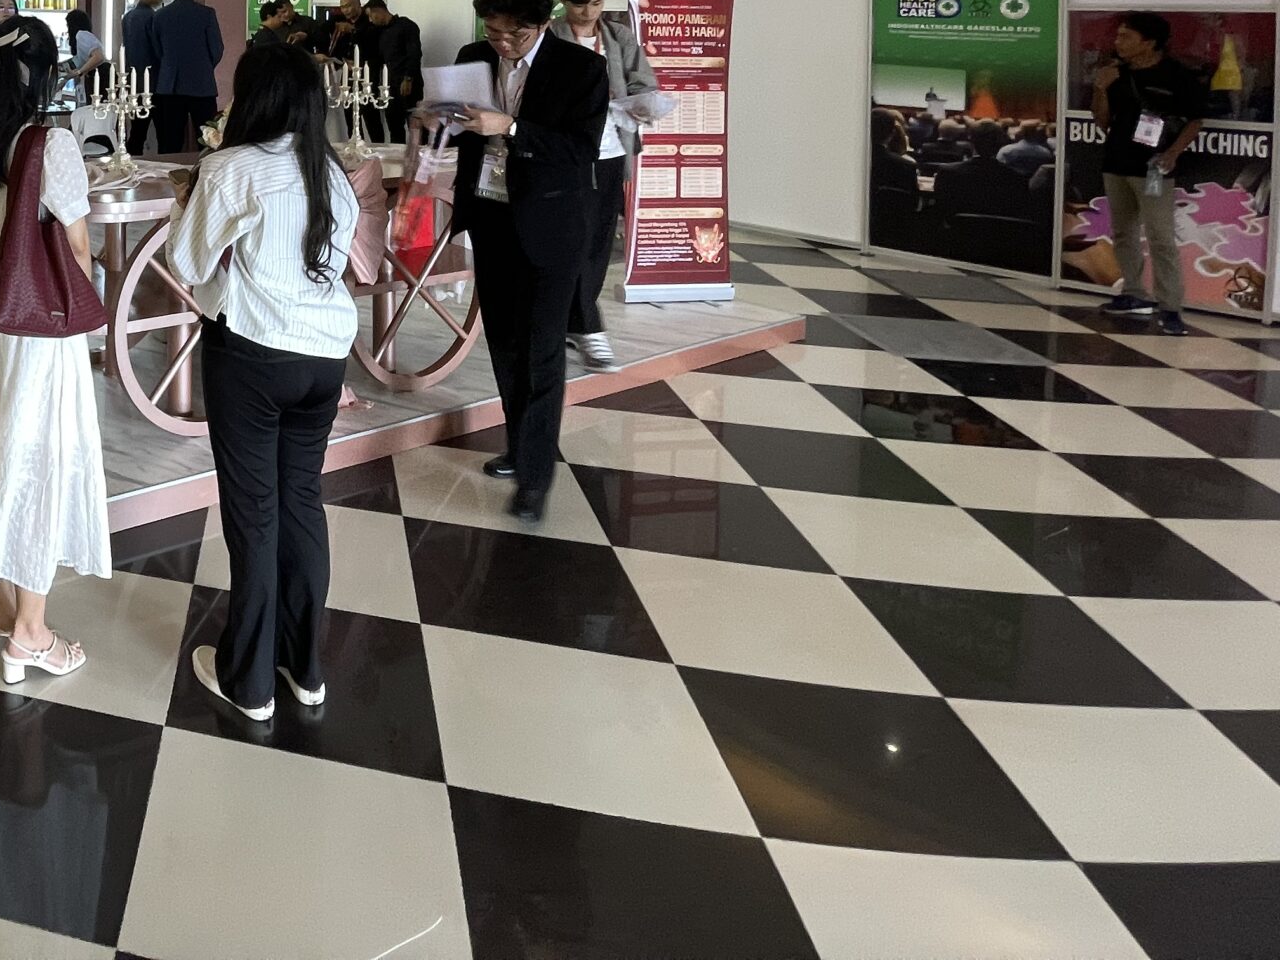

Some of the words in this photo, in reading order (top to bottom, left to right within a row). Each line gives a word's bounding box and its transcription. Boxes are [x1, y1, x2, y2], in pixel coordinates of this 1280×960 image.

[639, 12, 676, 24] PROMO
[678, 13, 726, 25] PAMERAN
[900, 9, 936, 17] CARE
[648, 26, 682, 37] HANYA
[684, 27, 690, 37] 3
